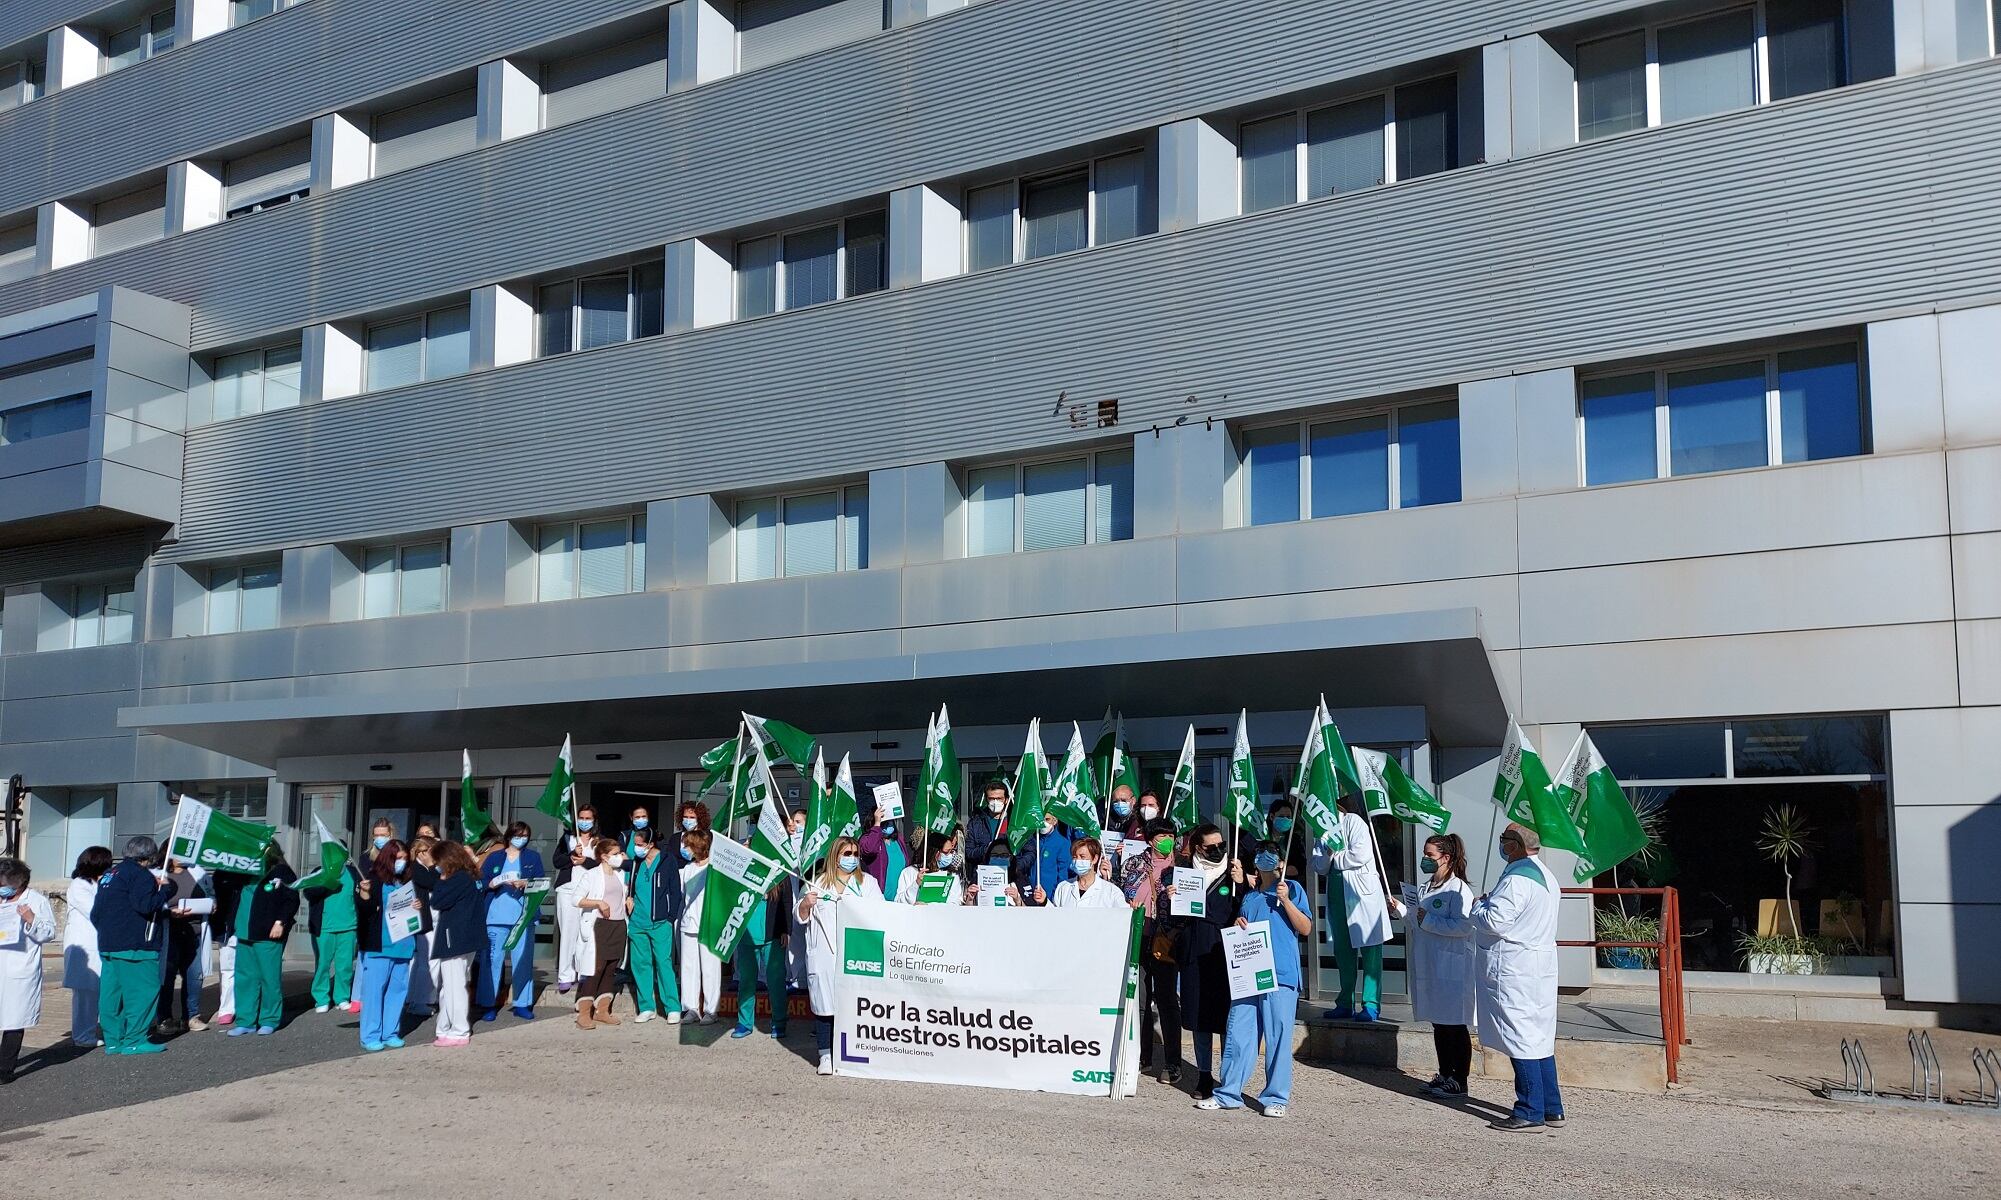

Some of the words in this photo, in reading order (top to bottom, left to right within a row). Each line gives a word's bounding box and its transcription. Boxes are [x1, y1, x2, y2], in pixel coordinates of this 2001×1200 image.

[1305, 793, 1343, 845] ATSE
[201, 848, 262, 871] SATSE
[889, 941, 945, 957] Sindicato
[1242, 944, 1263, 953] nuestros
[1248, 938, 1261, 946] salud
[1235, 950, 1260, 959] hospitales
[846, 960, 882, 972] SATSE
[889, 956, 903, 968] de
[905, 957, 971, 974] Enfermería
[889, 971, 899, 979] Lo
[900, 973, 914, 982] que
[915, 975, 928, 983] nos
[929, 976, 944, 984] une
[856, 997, 895, 1019] Por
[901, 1001, 920, 1022] la
[926, 1006, 993, 1028] salud
[999, 1010, 1033, 1030] de
[856, 1024, 960, 1048] nuestros
[966, 1029, 1101, 1058] hospitales
[855, 1043, 934, 1057] #ExigimosSoluciones
[1072, 1069, 1115, 1084] SATS
